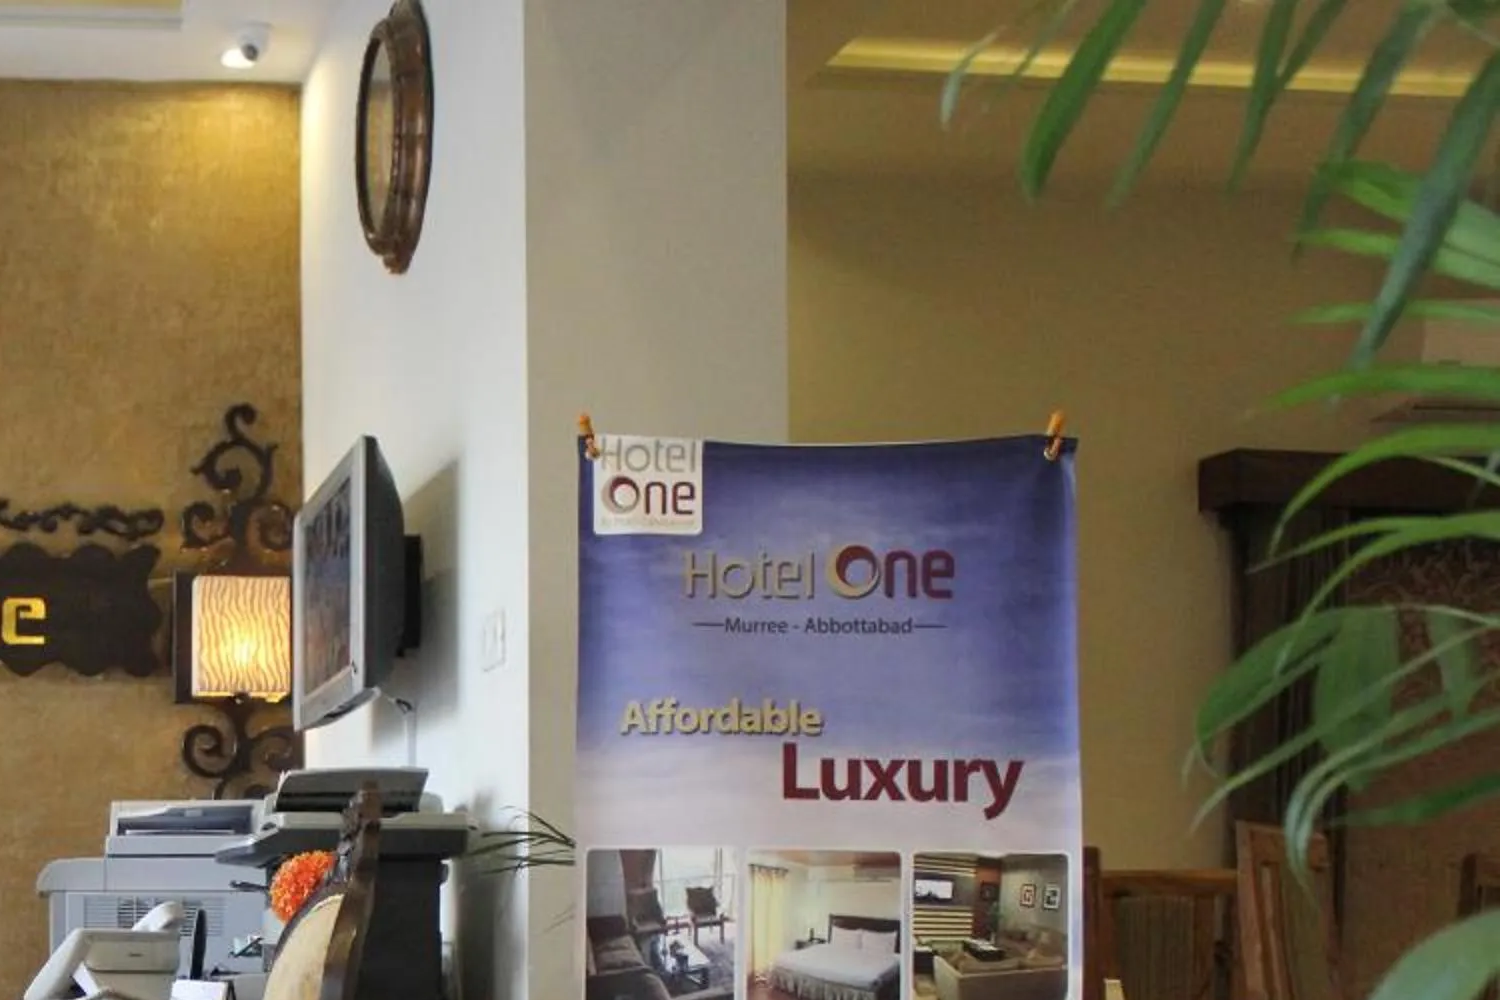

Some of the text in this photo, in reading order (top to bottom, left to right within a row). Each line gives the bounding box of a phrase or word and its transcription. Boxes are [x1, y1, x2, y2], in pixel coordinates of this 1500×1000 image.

[601, 435, 696, 473] Hotel
[601, 475, 696, 516] One
[683, 544, 955, 600] Hotel One
[724, 618, 789, 634] Murree
[804, 617, 913, 634] Abbottabad
[619, 700, 824, 736] Affordable
[781, 742, 1025, 821] Luxury
